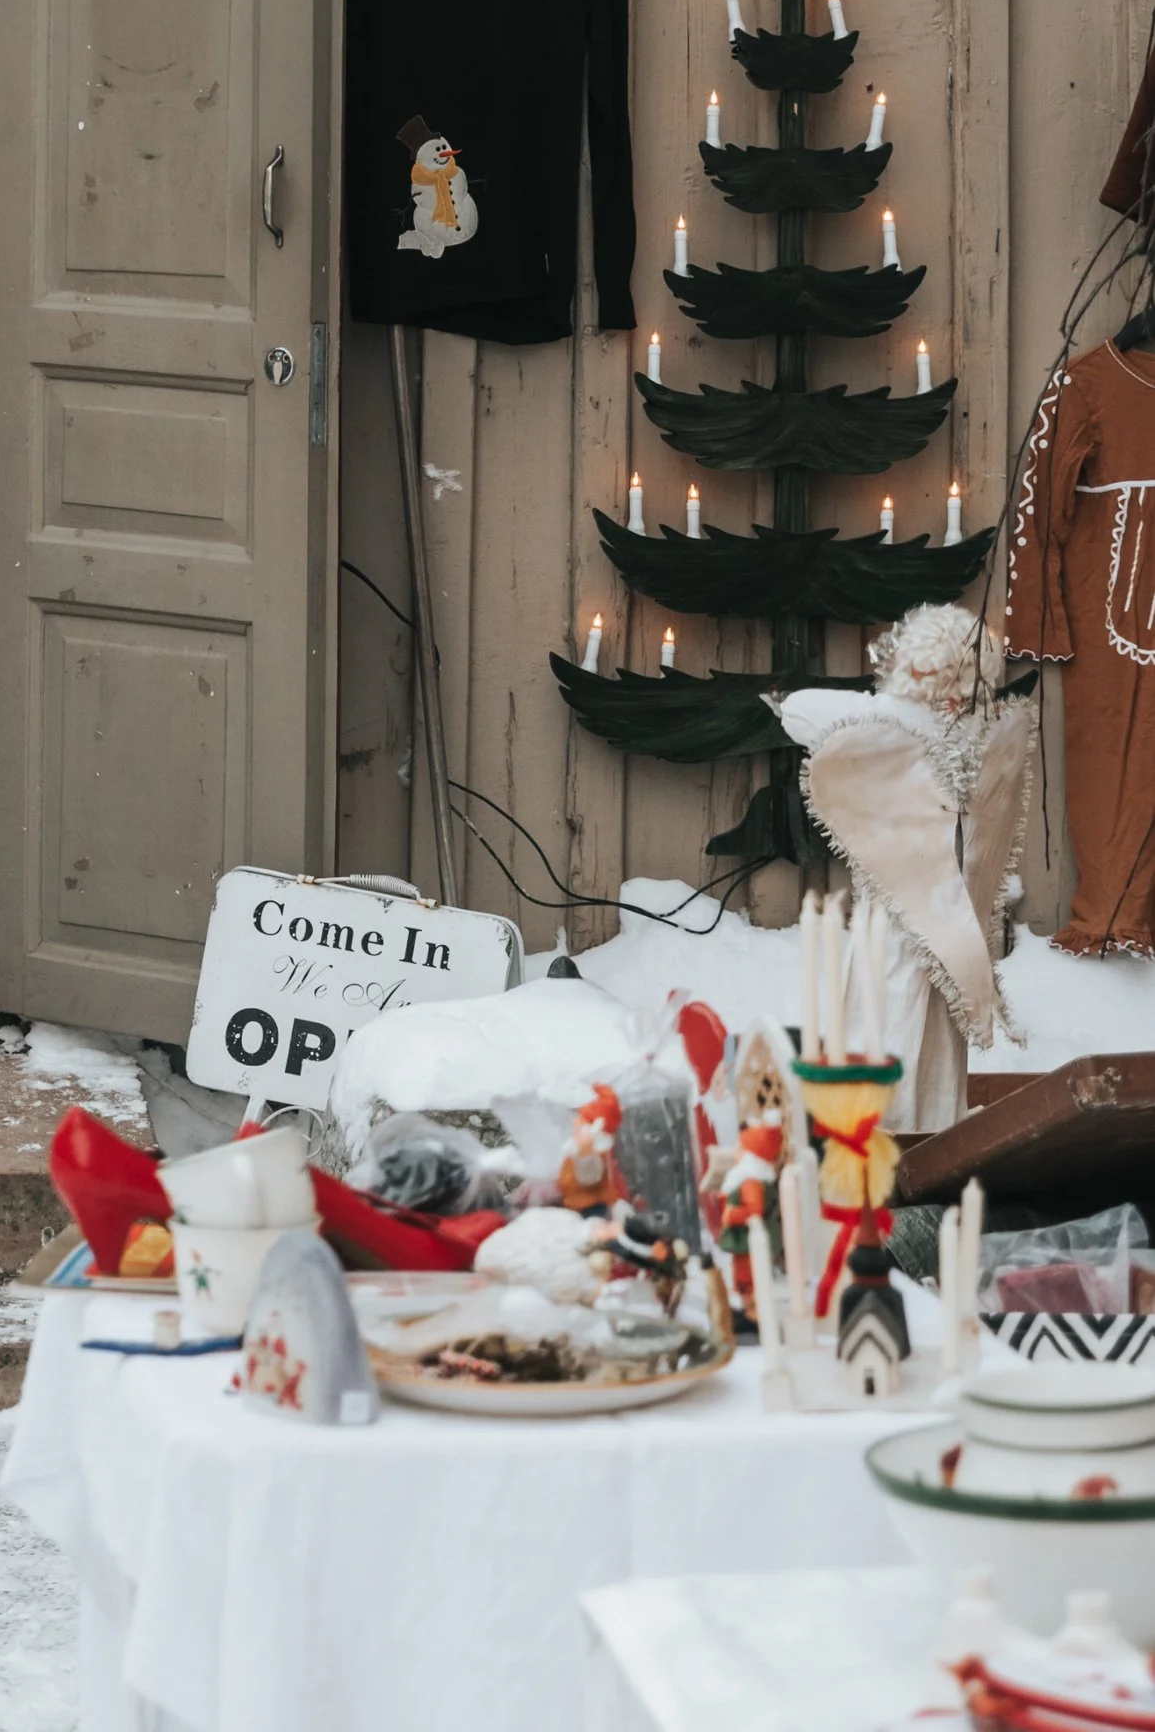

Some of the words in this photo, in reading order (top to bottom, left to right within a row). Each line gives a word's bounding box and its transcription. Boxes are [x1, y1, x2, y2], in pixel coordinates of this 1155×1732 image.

[252, 899, 385, 956] Come
[398, 926, 451, 971] In
[272, 954, 334, 999] We
